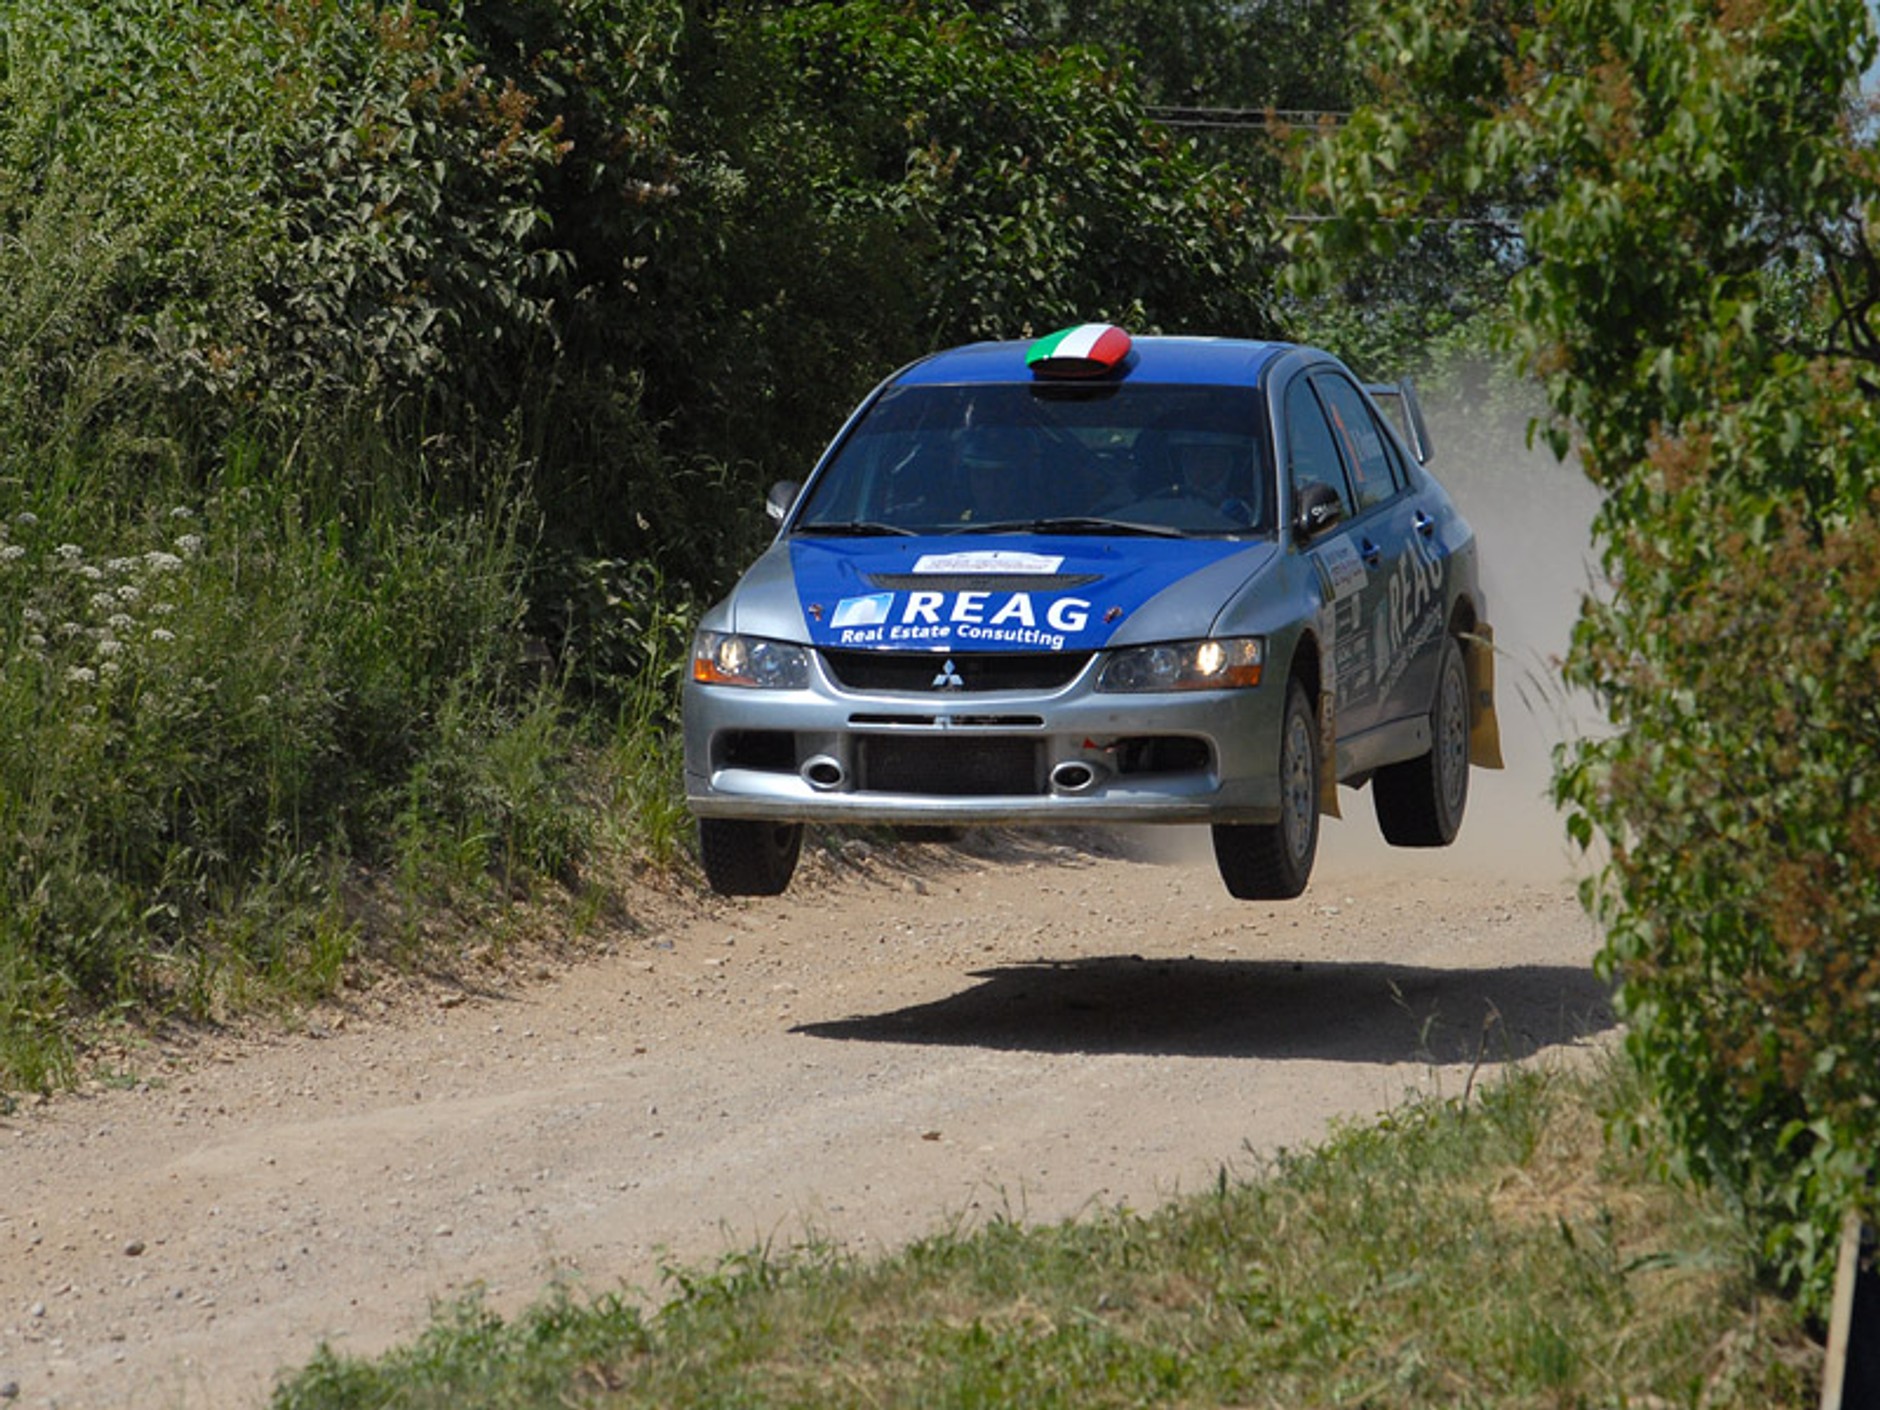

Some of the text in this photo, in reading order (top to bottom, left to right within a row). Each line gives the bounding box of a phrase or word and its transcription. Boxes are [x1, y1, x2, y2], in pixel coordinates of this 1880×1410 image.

[902, 591, 1091, 631] REAG
[841, 624, 1065, 650] Real Estate Consulting
